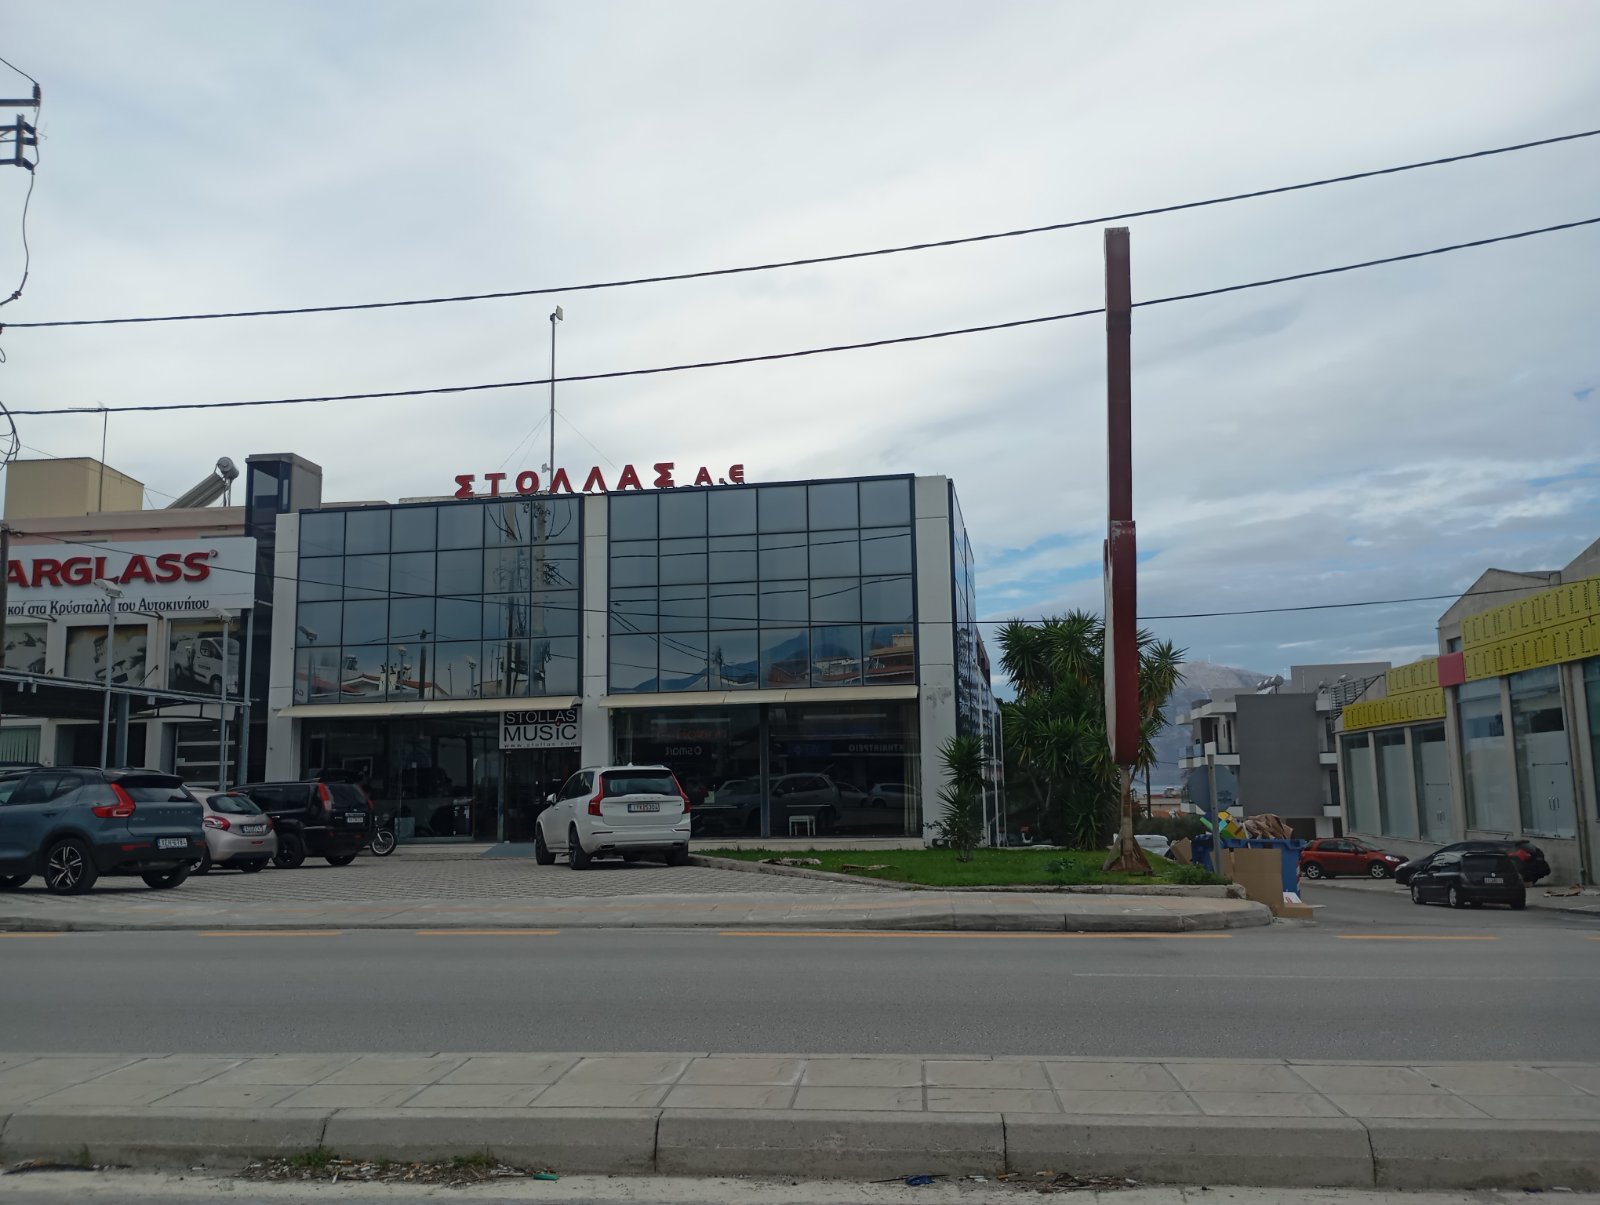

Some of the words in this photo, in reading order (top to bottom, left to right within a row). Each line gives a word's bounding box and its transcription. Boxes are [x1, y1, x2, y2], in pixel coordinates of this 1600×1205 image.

[455, 462, 674, 498] ΣΤΟΛΛΑΣ
[28, 605, 46, 615] στα
[118, 602, 135, 612] του
[138, 596, 210, 612] Αυτοκινήτου
[506, 709, 576, 724] STOLLAS
